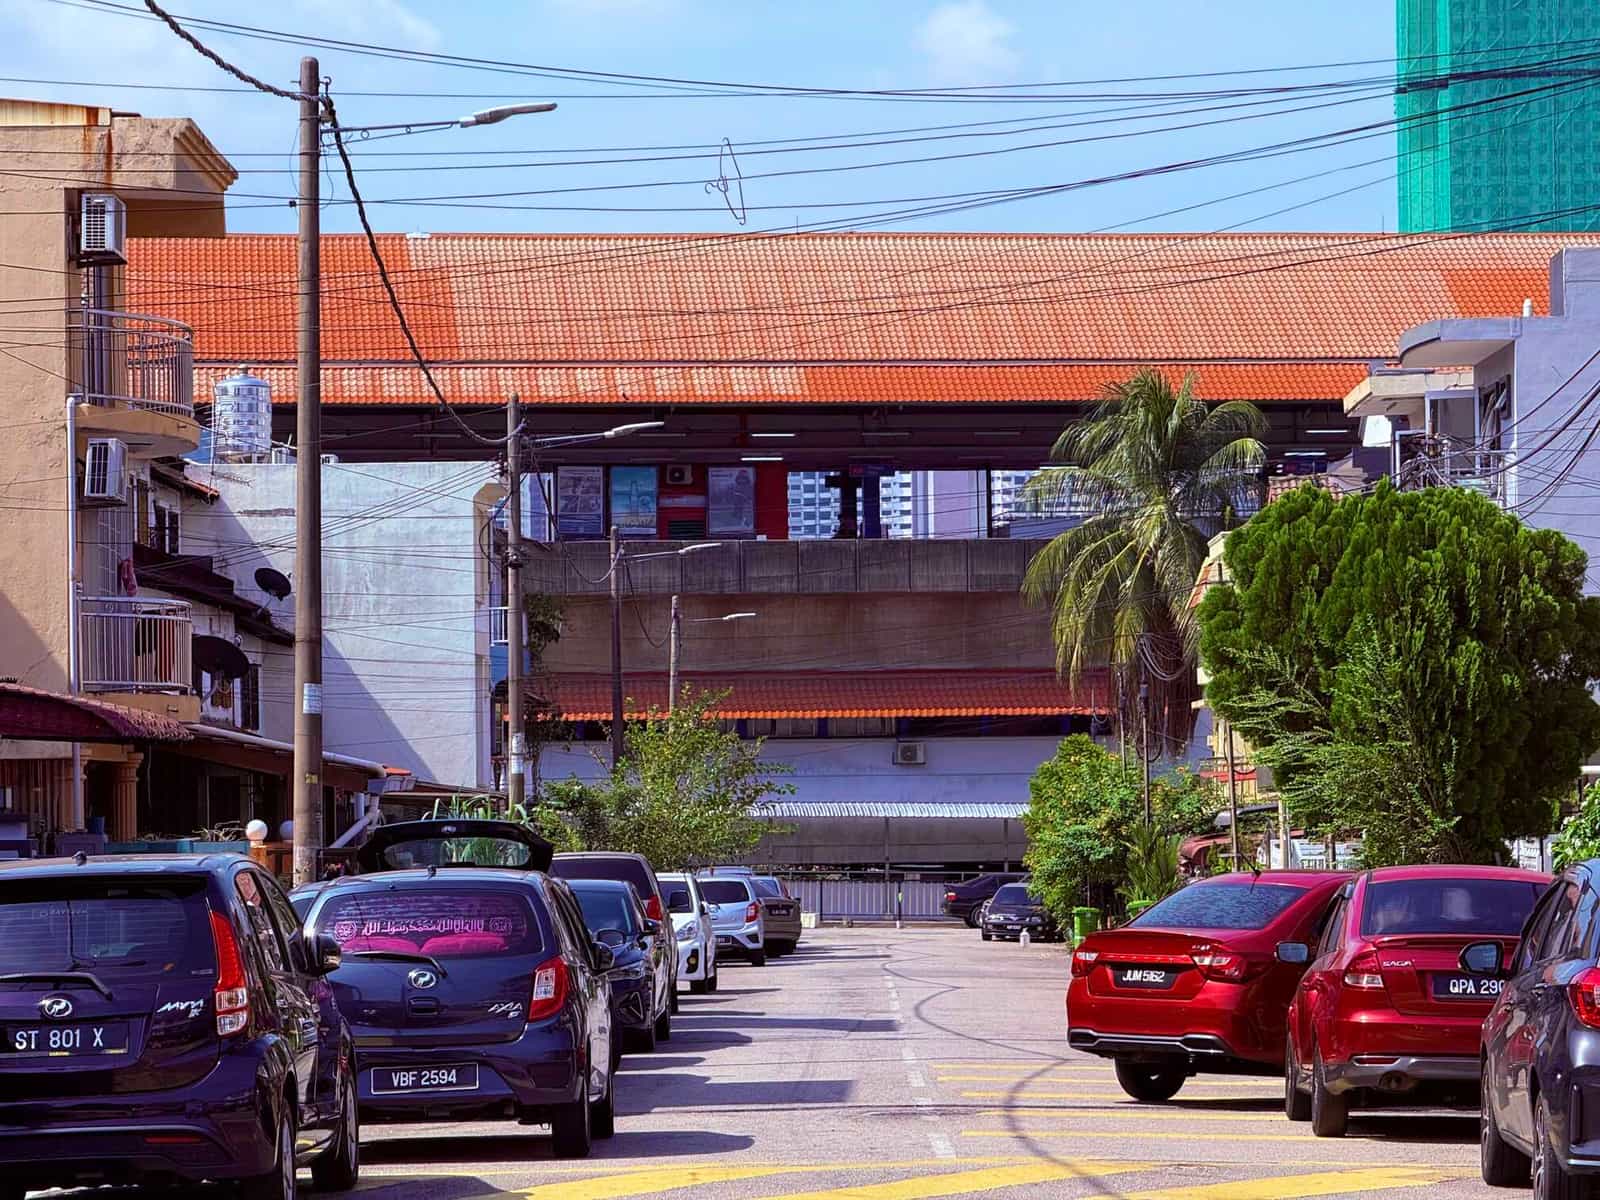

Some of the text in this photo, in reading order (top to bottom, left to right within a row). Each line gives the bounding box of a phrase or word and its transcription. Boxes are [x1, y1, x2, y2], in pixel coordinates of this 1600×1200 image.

[1122, 969, 1143, 981] JUM
[1449, 979, 1476, 994] QPA
[15, 1027, 104, 1050] ST 801 X
[391, 1069, 457, 1087] VBF 2594
